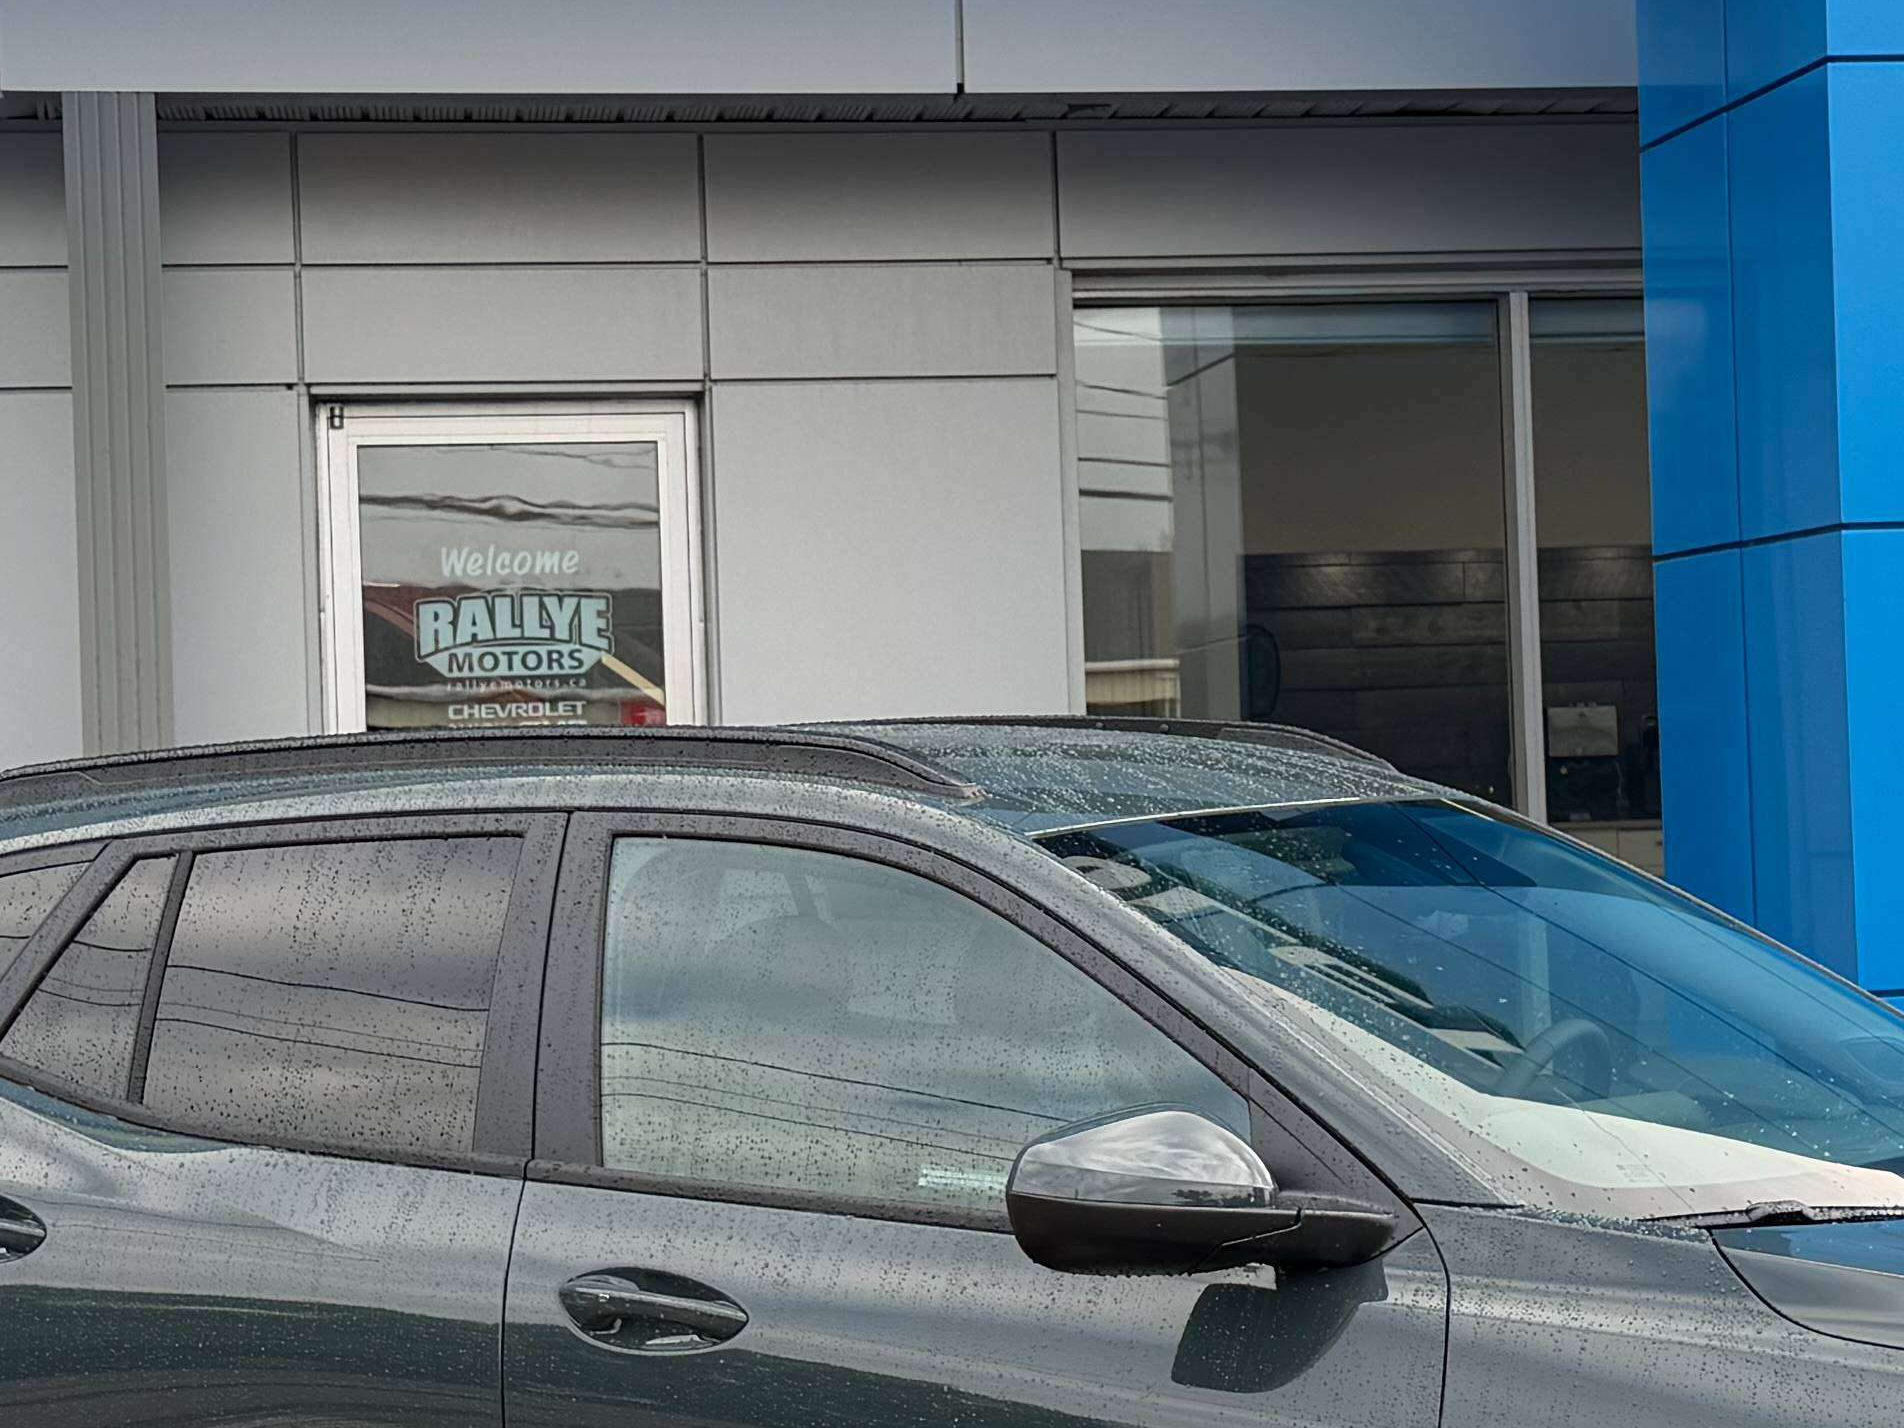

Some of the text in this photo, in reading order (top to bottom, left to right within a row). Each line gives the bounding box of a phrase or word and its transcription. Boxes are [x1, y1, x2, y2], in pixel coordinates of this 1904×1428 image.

[440, 544, 580, 578] Welcome
[416, 593, 612, 660] RALLYE
[447, 648, 585, 674] MOTORS
[446, 677, 588, 693] rallyemotors.ca
[447, 700, 587, 720] CHEVROLET
